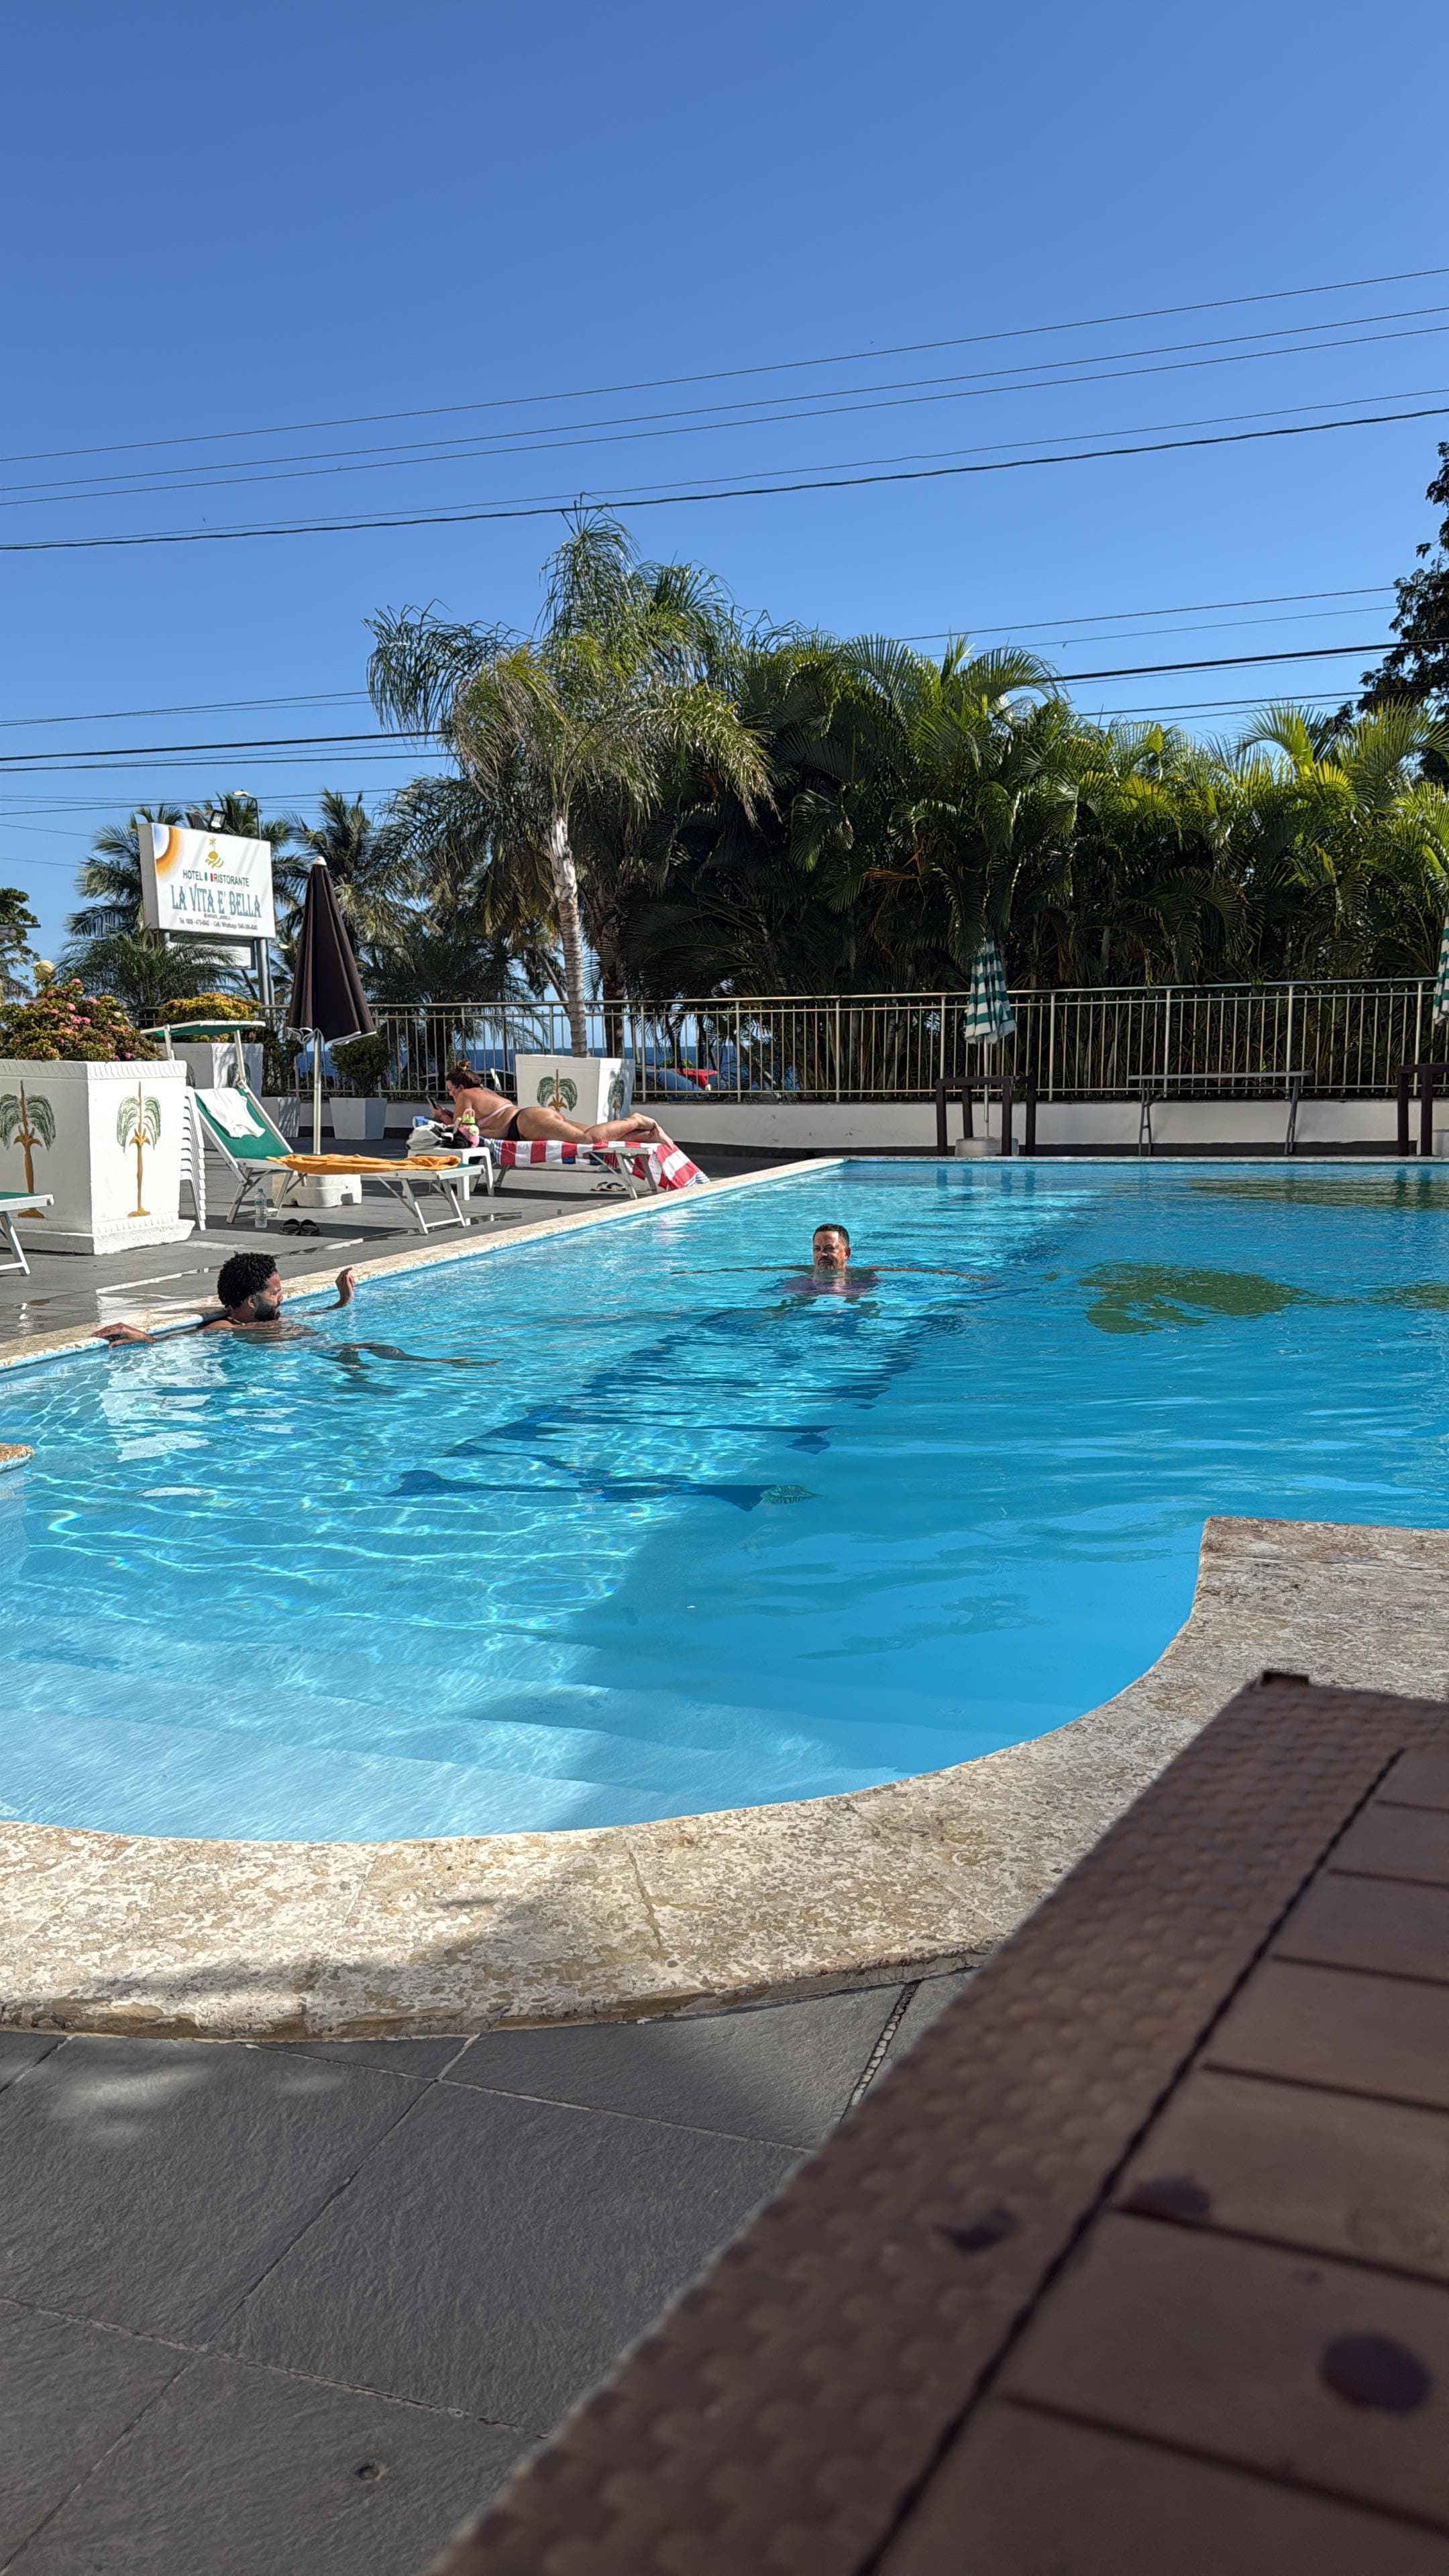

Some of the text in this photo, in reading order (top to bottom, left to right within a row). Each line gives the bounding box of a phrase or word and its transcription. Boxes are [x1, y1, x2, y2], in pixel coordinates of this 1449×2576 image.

[183, 869, 250, 887] HOTEL RISTORANTE
[170, 885, 187, 910] LA
[189, 883, 215, 913] VITA
[229, 891, 262, 918] BELLA
